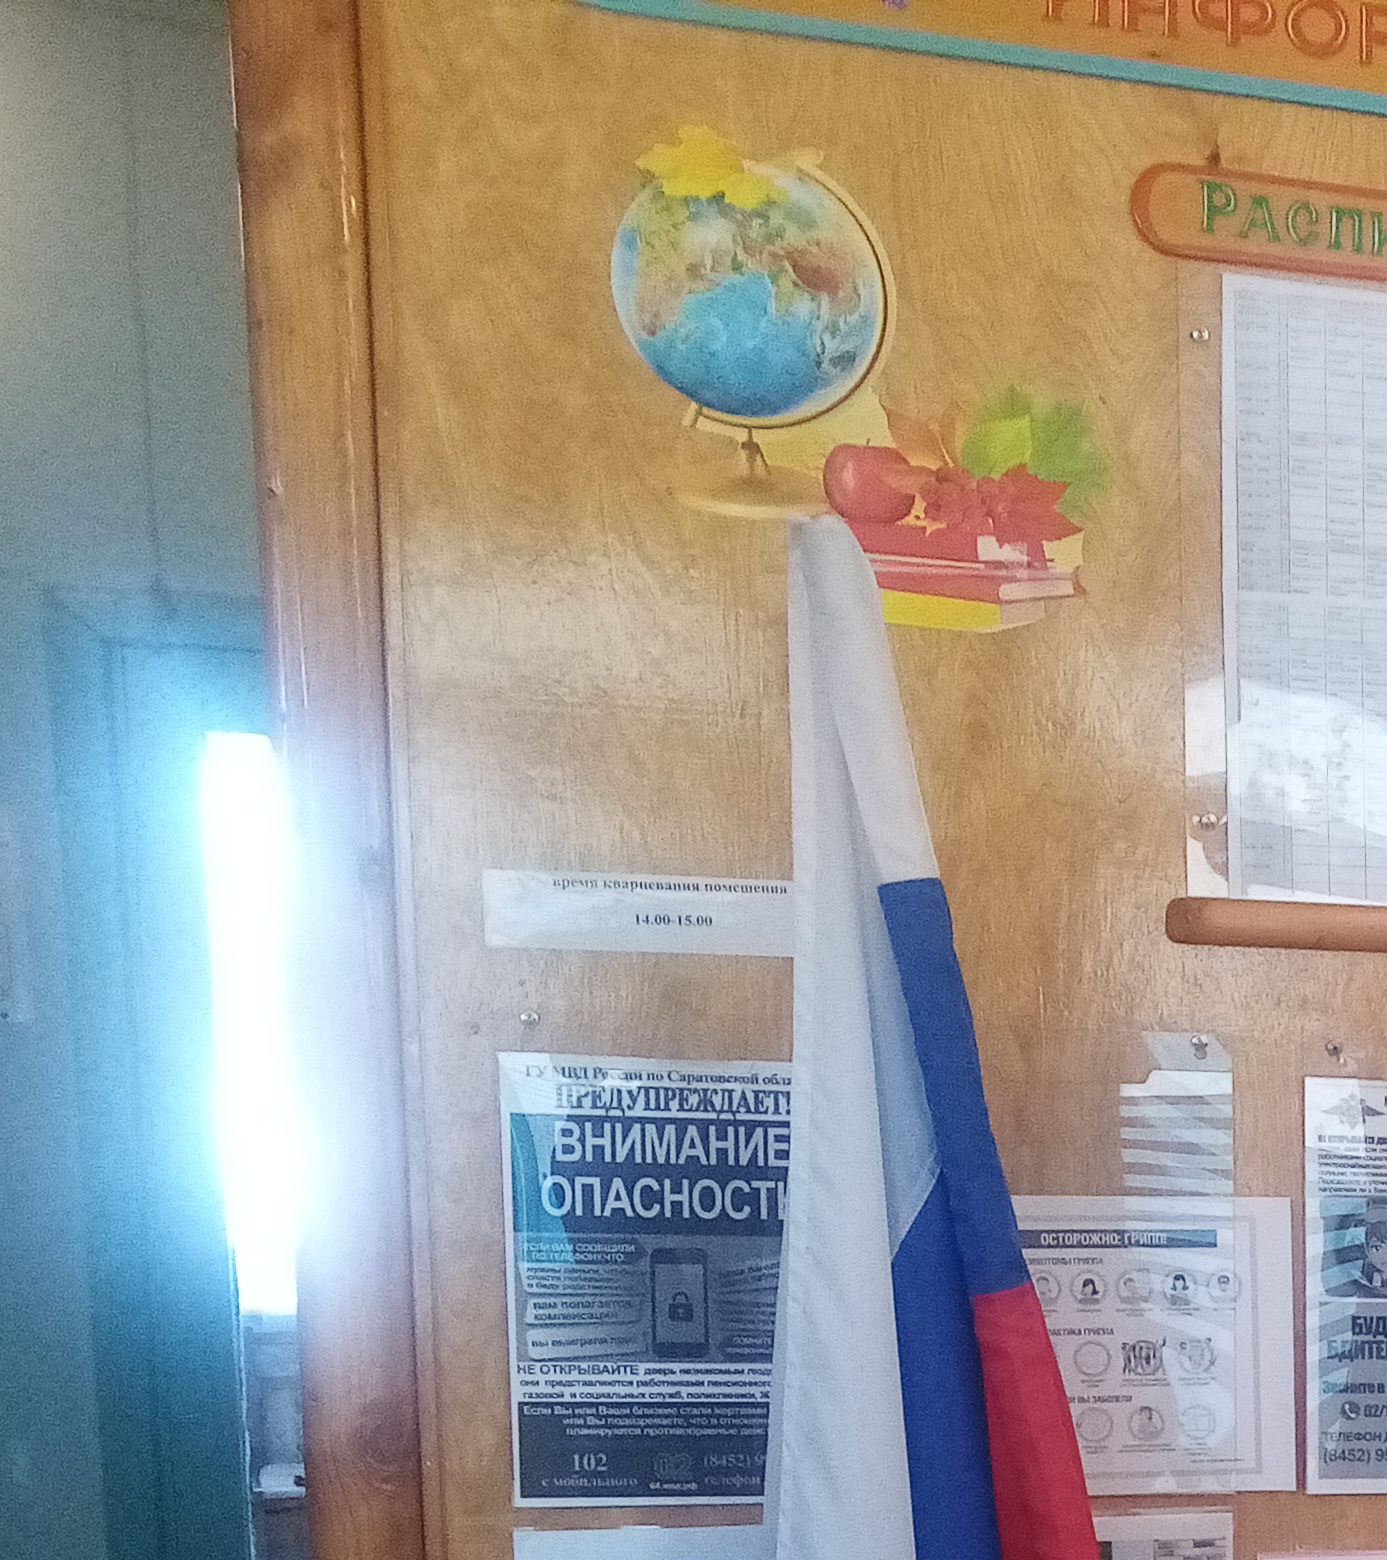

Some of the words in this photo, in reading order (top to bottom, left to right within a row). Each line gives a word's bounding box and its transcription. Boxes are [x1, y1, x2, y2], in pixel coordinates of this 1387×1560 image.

[634, 913, 713, 927] 14.00-15.00
[647, 1072, 664, 1082] по
[667, 1071, 760, 1085] Саратовской
[1040, 1232, 1121, 1246] ОСТОРОЖНО:
[517, 1364, 536, 1375] НЕ
[540, 1364, 640, 1375] ОТКРЫВАЙТЕ
[1321, 1432, 1381, 1441] ТЕЛЕФОН
[572, 1452, 609, 1472] 102
[1323, 1448, 1371, 1464] (8452)
